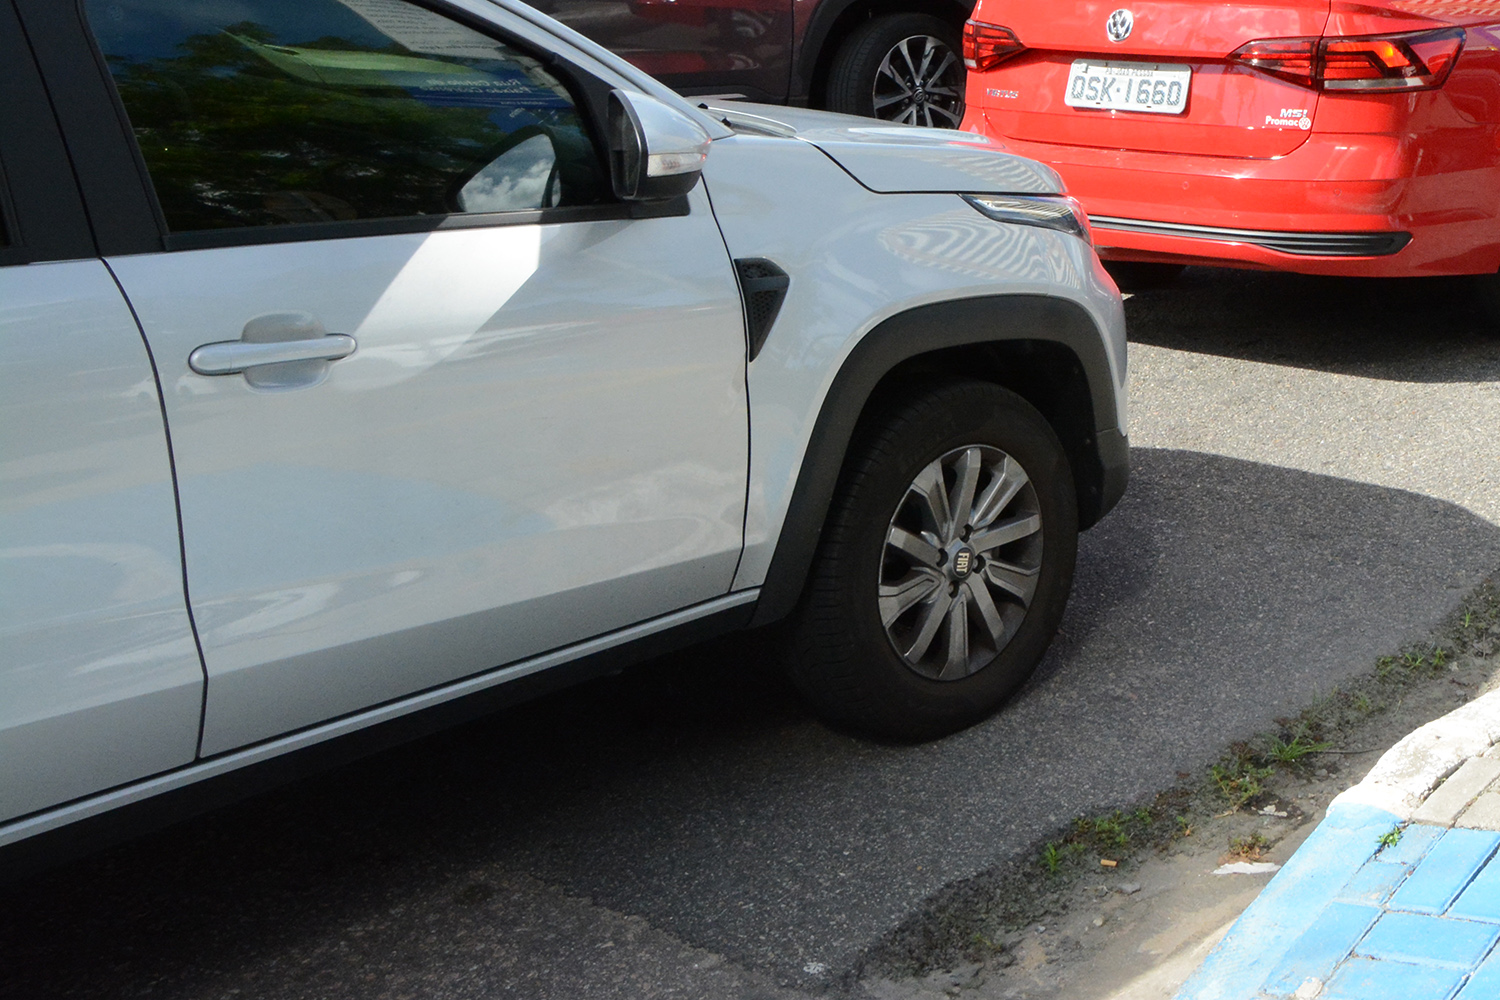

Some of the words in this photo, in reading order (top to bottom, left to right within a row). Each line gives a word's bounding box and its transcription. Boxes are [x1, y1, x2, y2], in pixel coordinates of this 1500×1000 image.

[985, 87, 1019, 99] VIRTUS
[1265, 115, 1299, 127] Promac
[956, 552, 970, 573] FIAT
